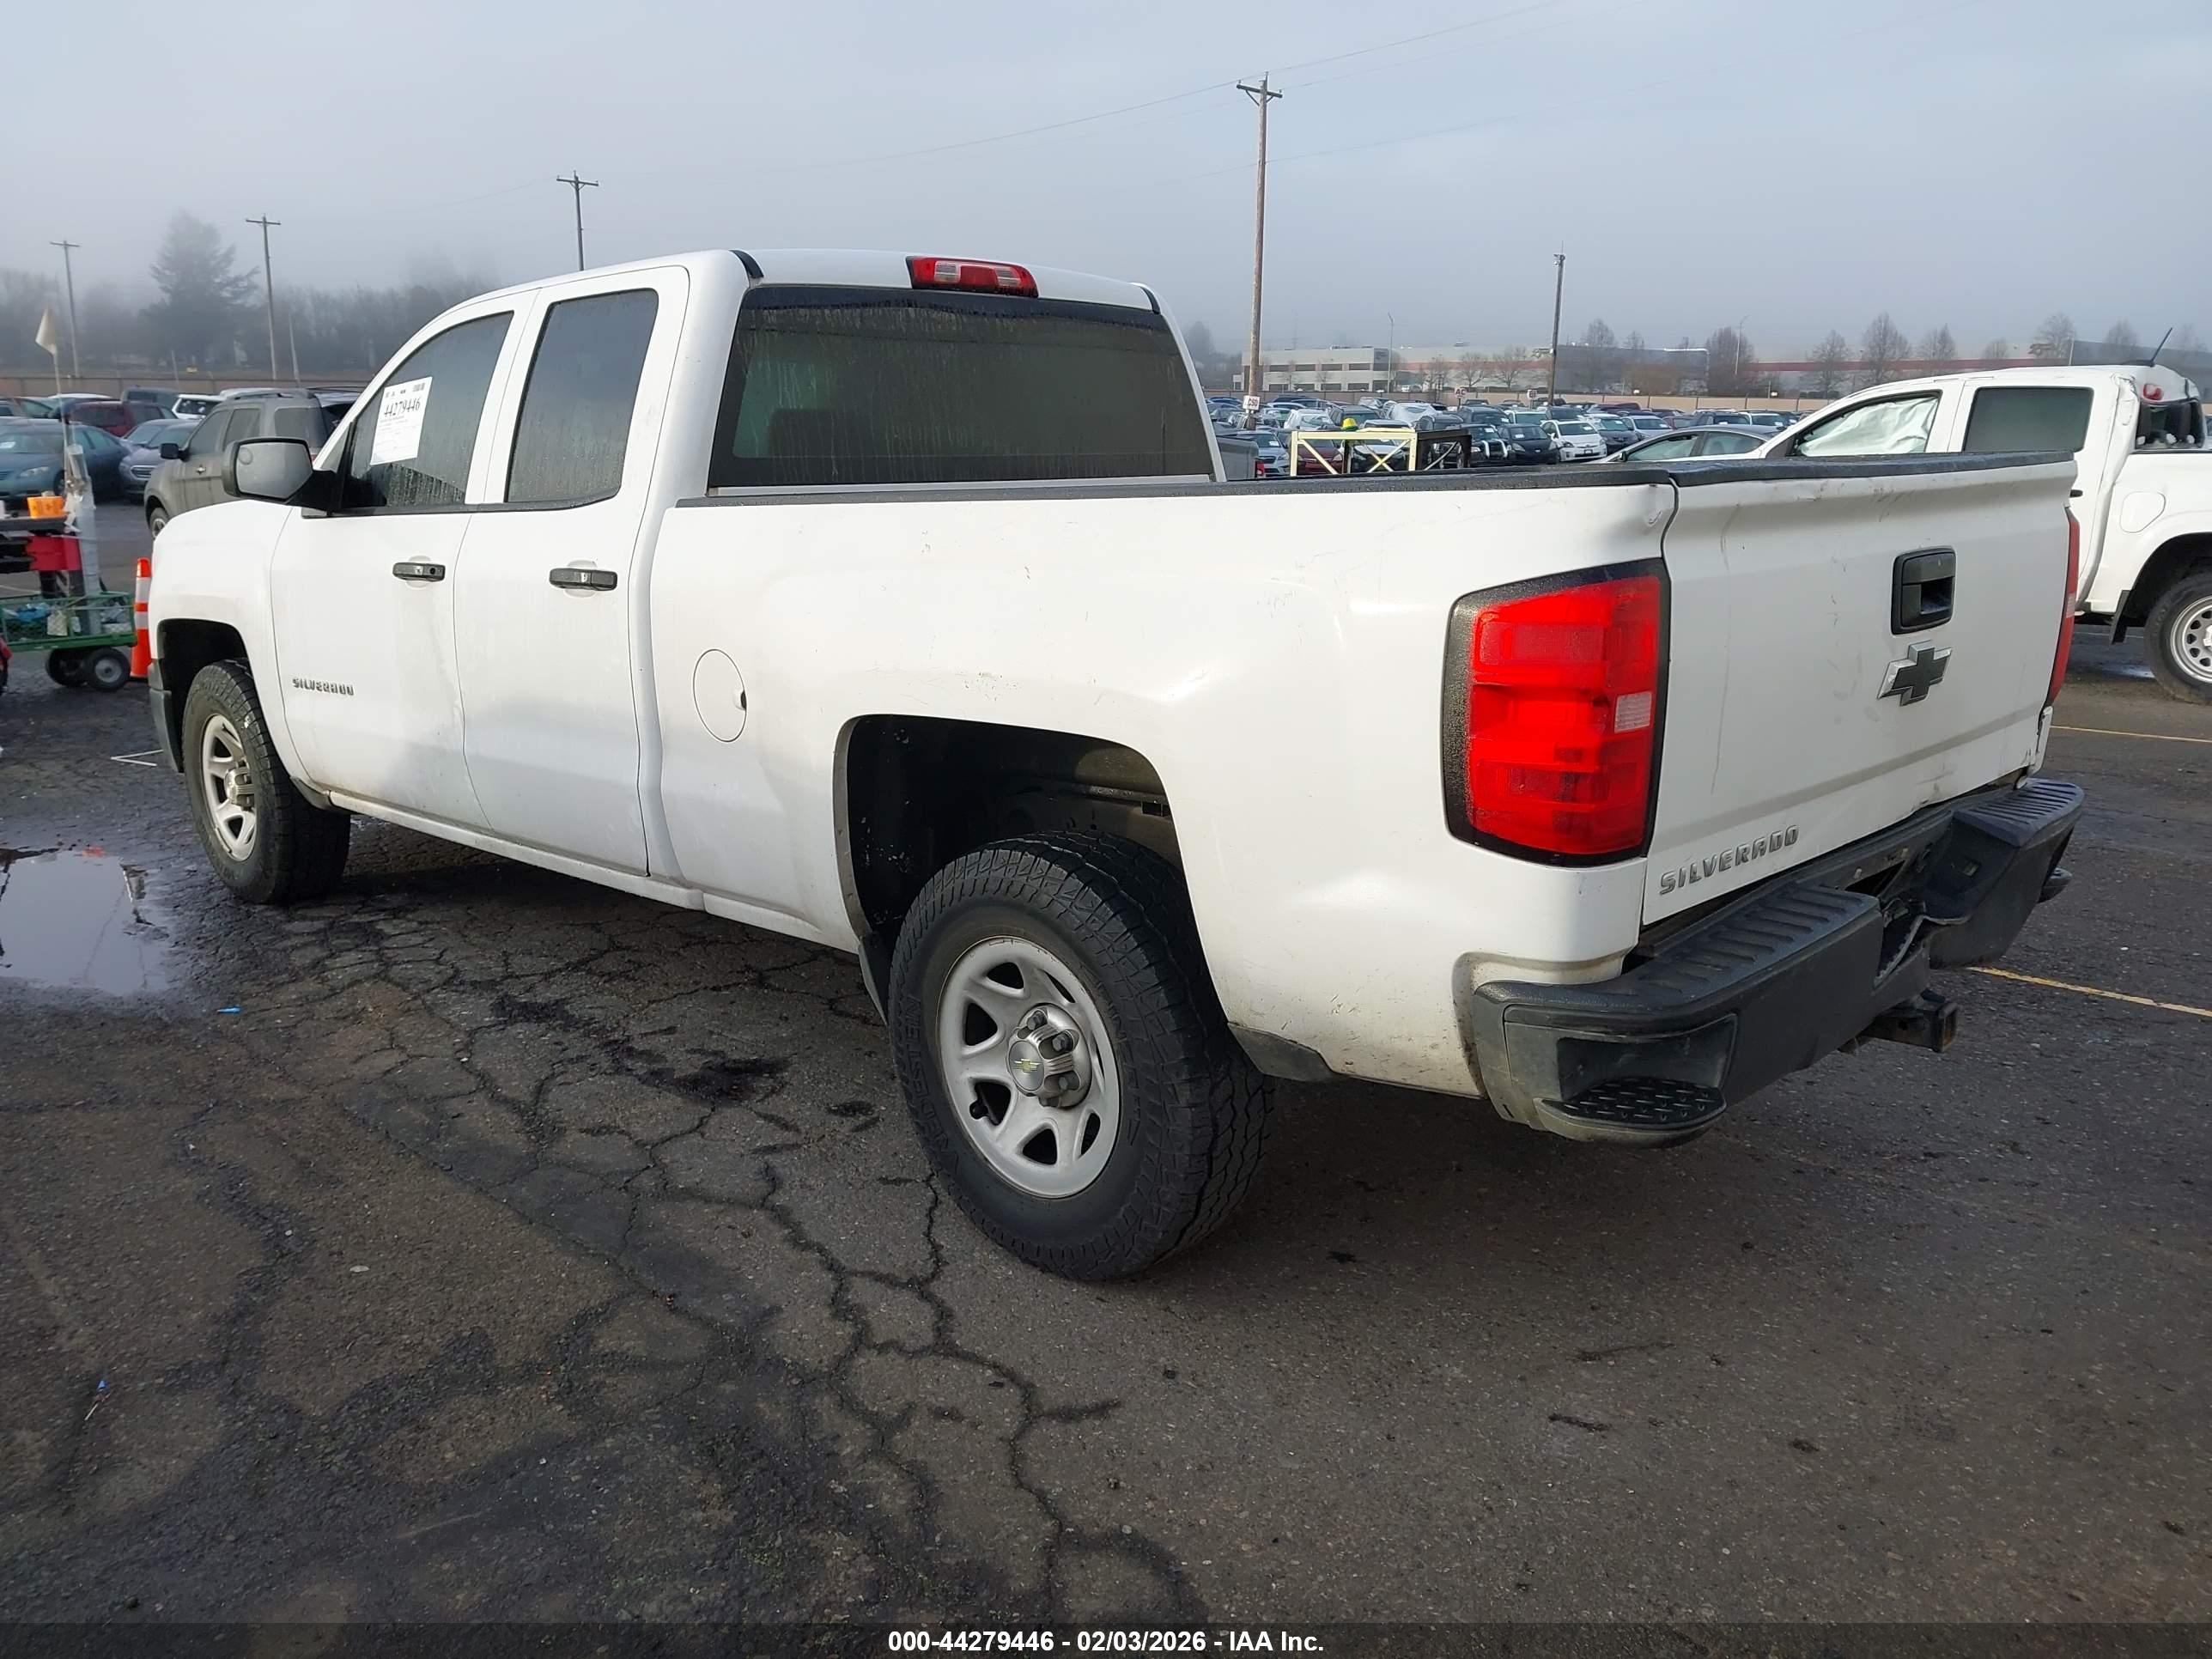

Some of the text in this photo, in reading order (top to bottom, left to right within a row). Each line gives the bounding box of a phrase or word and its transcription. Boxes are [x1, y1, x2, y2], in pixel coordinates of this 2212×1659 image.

[384, 396, 422, 417] 44279446
[292, 678, 354, 696] SILVERADO
[1659, 824, 1800, 895] SILVERADO
